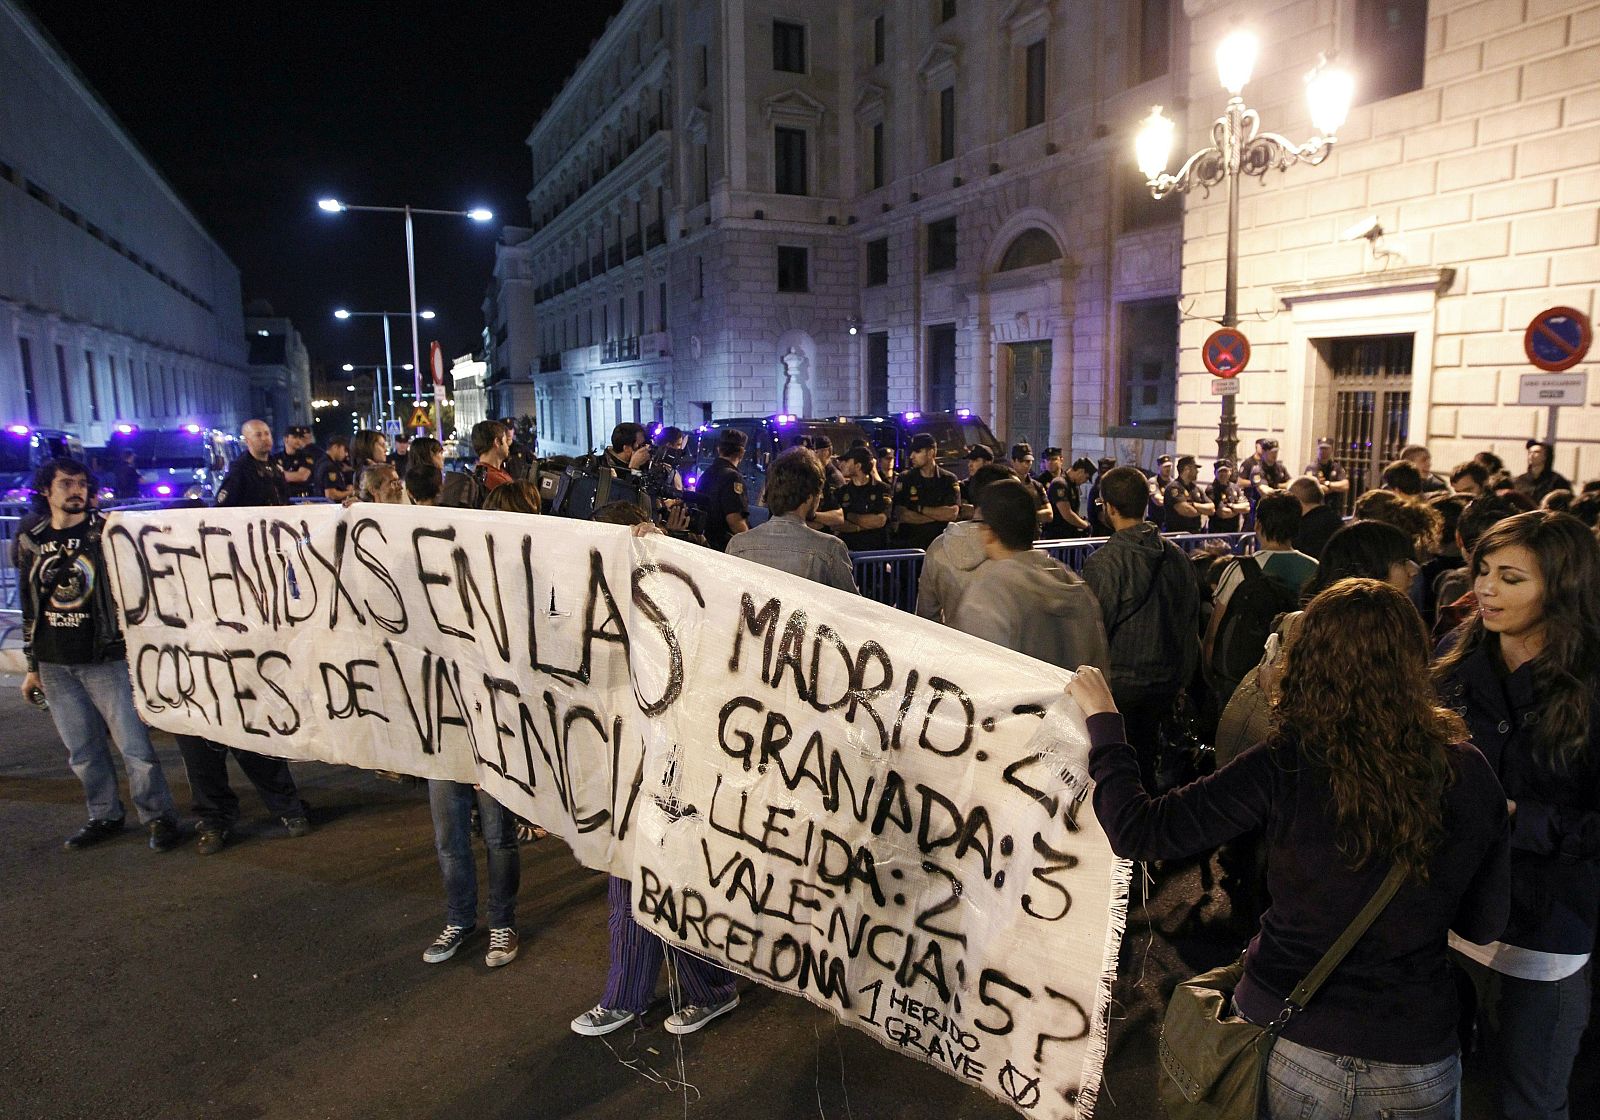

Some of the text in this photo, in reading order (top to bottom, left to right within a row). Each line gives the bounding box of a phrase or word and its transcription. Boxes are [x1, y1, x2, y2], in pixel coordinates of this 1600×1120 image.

[107, 517, 705, 718] DETENIDXS EN LAS
[136, 643, 300, 737] CORTES
[319, 658, 389, 723] DE
[729, 591, 995, 762] MADRID:
[708, 773, 967, 948] LLEIDA: 2
[718, 696, 1079, 921] GRANADA: 3
[639, 866, 981, 1053] BARCELONA 1 HERIDO
[701, 838, 966, 1013] VALENCIA:
[884, 1016, 987, 1082] GRAVE
